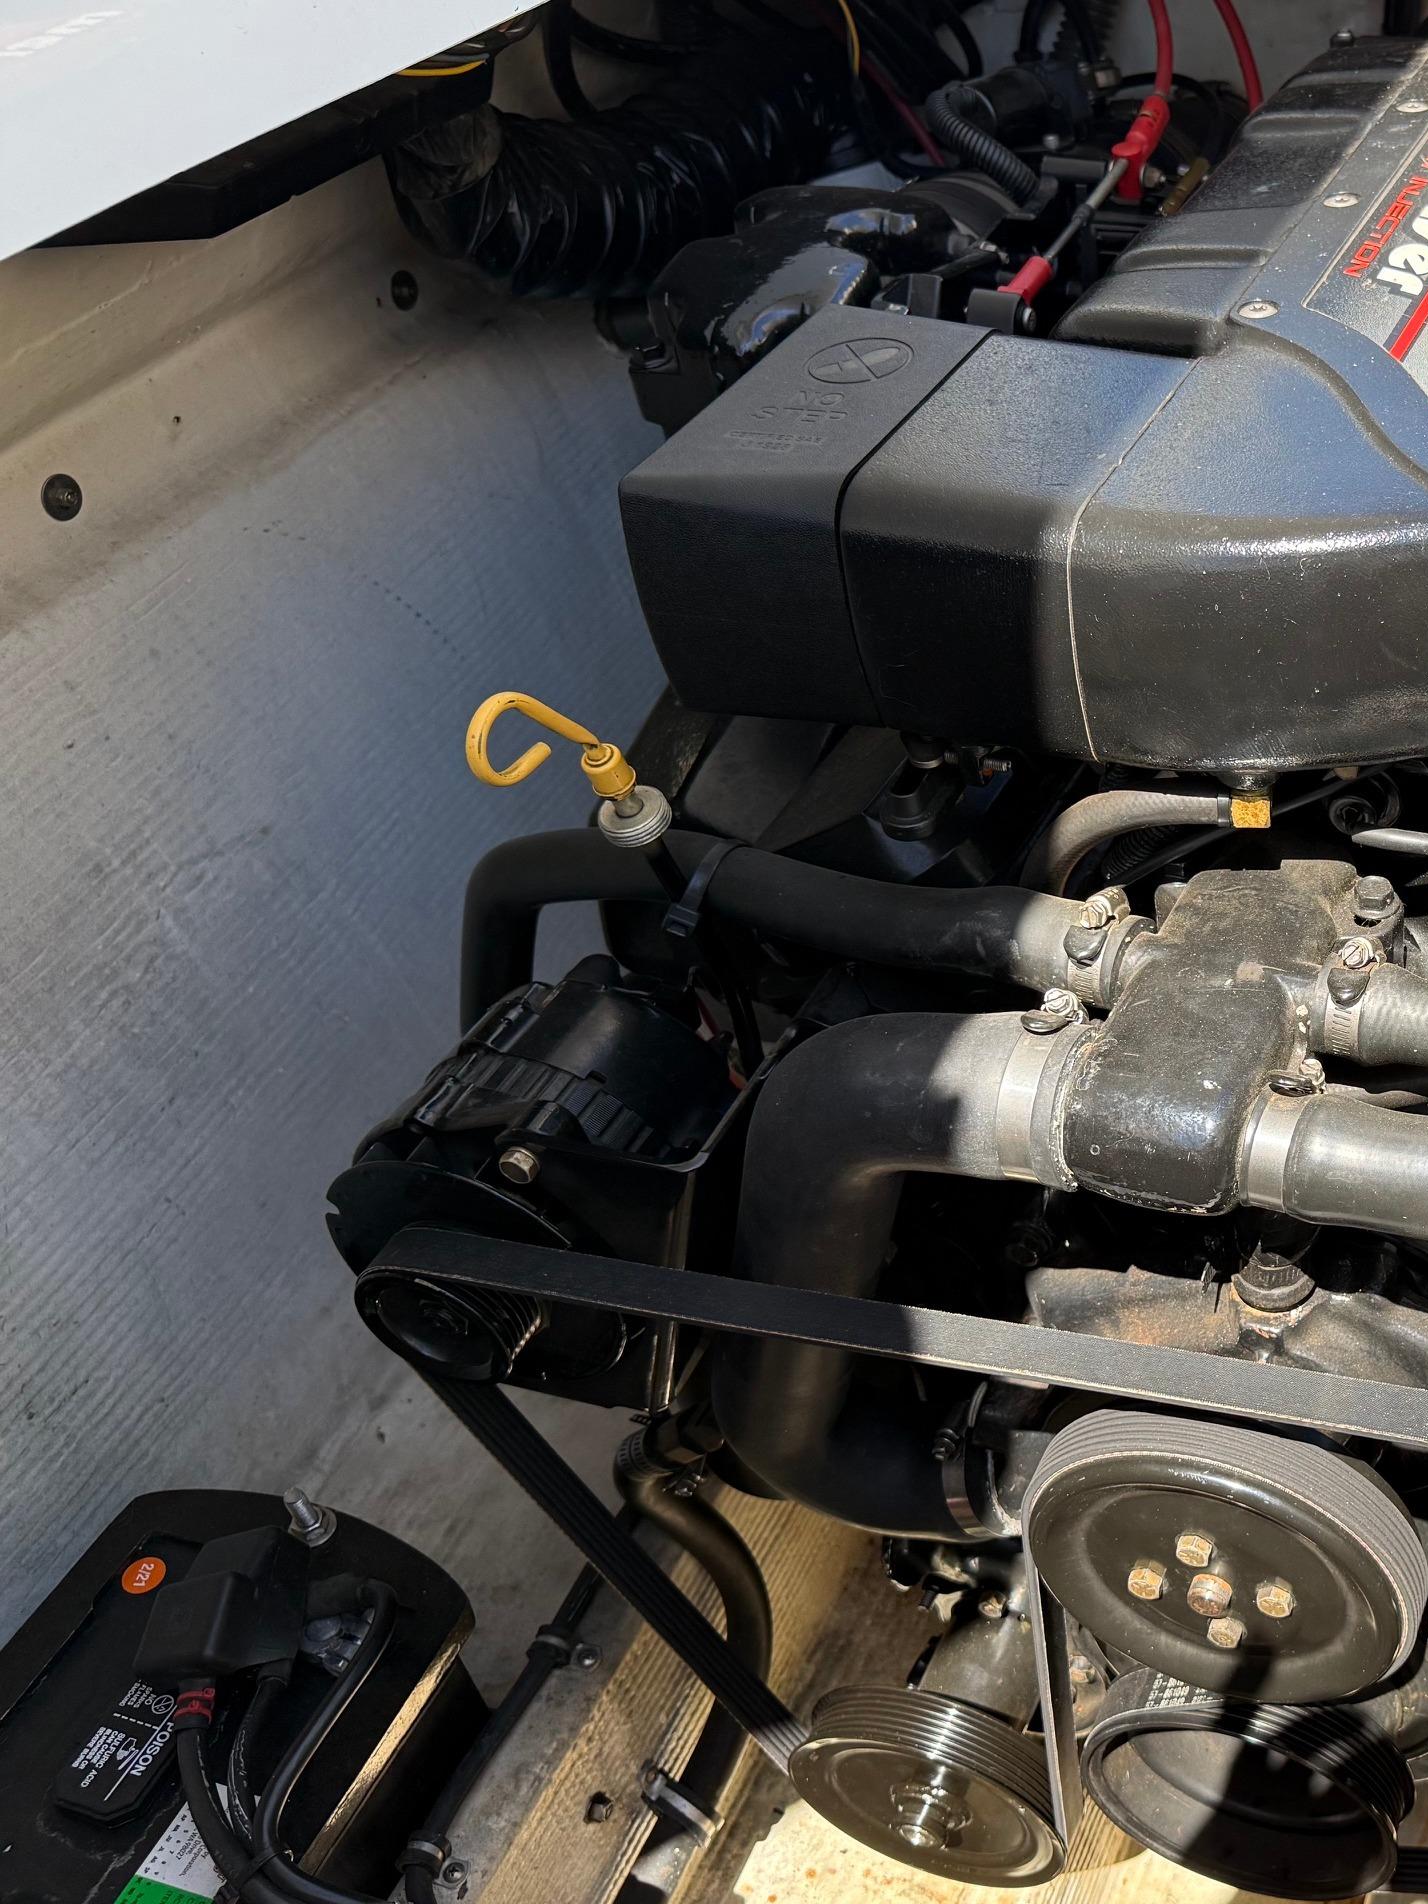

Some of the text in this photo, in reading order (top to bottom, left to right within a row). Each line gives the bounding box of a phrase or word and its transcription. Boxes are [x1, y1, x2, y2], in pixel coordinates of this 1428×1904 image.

[796, 390, 845, 405] NO
[749, 406, 848, 423] STEP
[133, 1563, 155, 1587] 2/21
[144, 1693, 157, 1706] NO
[71, 1726, 106, 1768] SEVERE BURNS
[78, 1728, 113, 1770] BLINDNESS OR
[80, 1732, 126, 1788] SULFURIC ACID
[90, 1730, 119, 1764] CAN CAUSE
